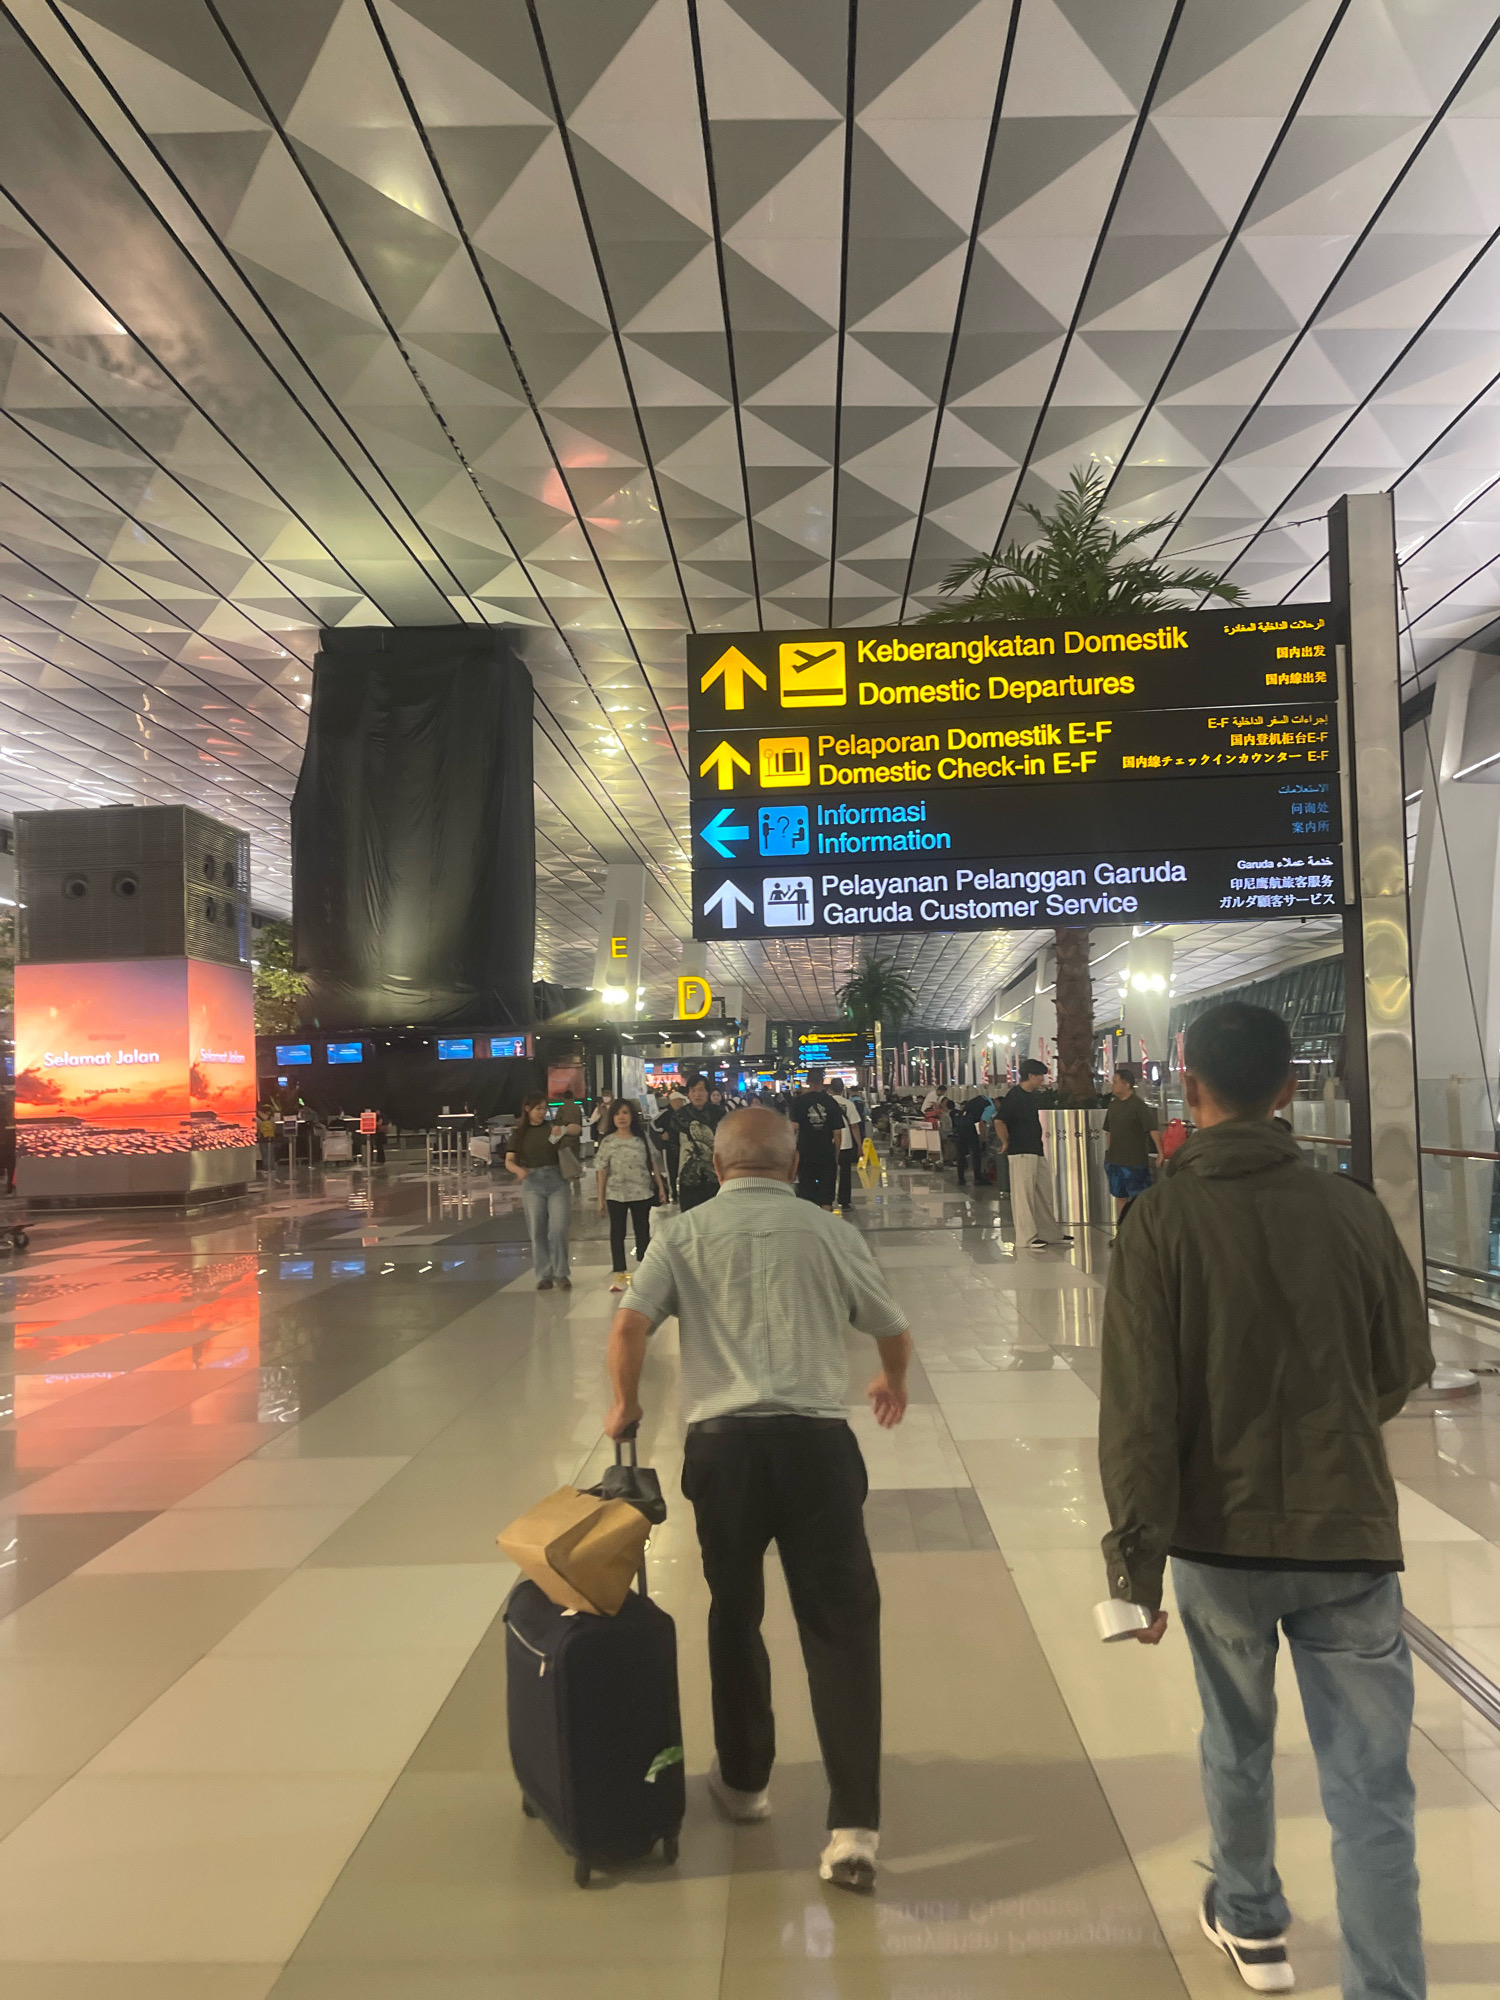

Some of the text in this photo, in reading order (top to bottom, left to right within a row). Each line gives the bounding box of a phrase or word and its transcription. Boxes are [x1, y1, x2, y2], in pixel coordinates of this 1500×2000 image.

[858, 627, 1188, 664] Keberangkatan Domestik
[1277, 645, 1325, 659] 国内出发
[1266, 672, 1327, 685] 国内線出発
[859, 675, 1135, 705] Domestic Departures
[1208, 718, 1229, 728] E-F
[818, 721, 1112, 759] Pelaporan Domestik E-F
[1308, 751, 1329, 761] E-F
[819, 751, 1097, 785] Domestic Check-in E-F
[818, 800, 926, 825] Informasi
[1292, 802, 1329, 814] 问询处
[1292, 821, 1329, 833] 案内所
[818, 829, 950, 853] Information
[1237, 860, 1274, 869] Garuda
[822, 861, 1187, 899] Pelayanan Pelanggan Garuda
[824, 891, 1138, 924] Garuda Customer Service
[610, 936, 629, 959] E
[677, 975, 713, 1020] D
[685, 984, 698, 1000] F
[43, 1048, 160, 1068] Selamat Jalan
[200, 1049, 246, 1064] Selamat Jalan
